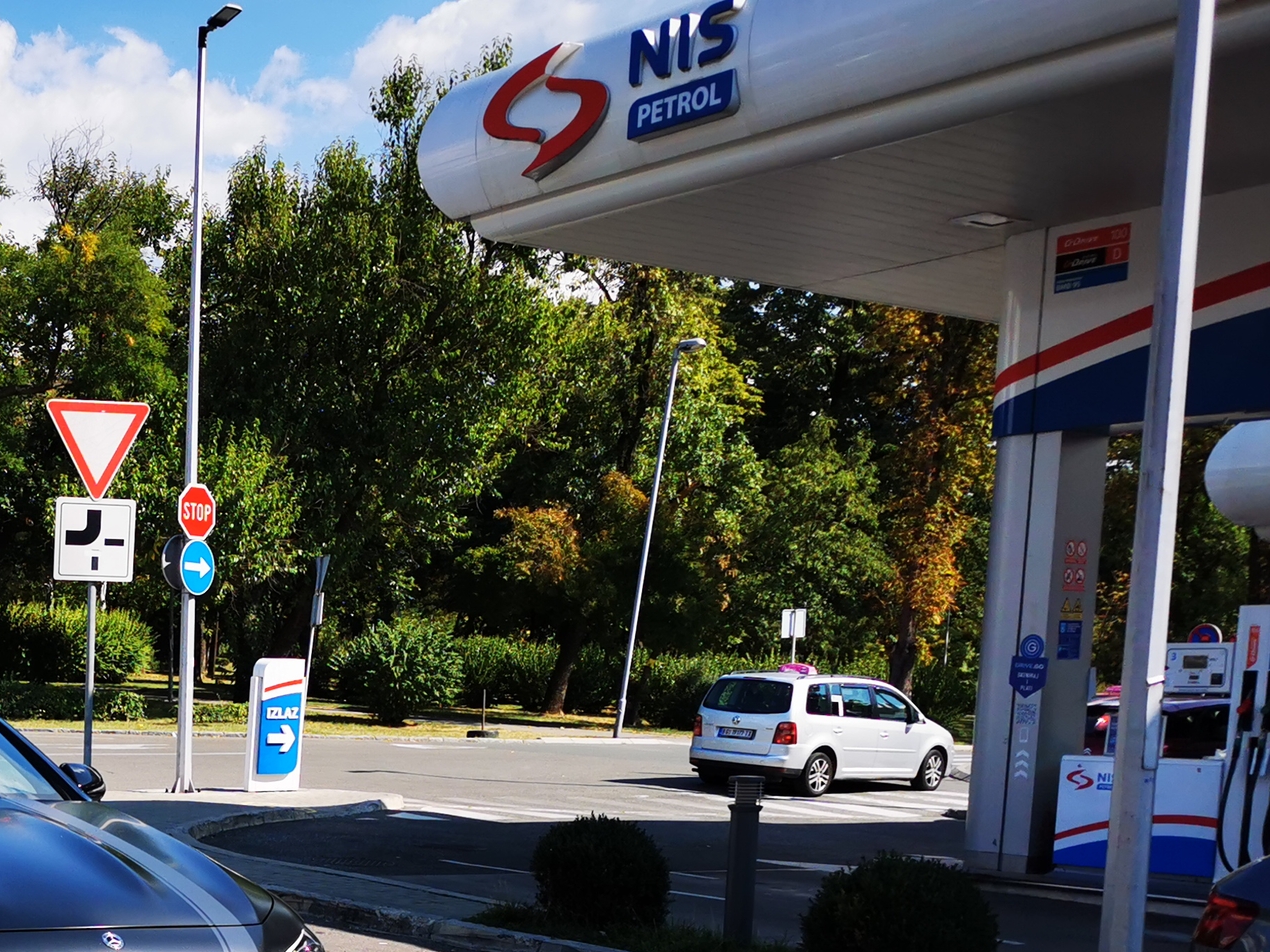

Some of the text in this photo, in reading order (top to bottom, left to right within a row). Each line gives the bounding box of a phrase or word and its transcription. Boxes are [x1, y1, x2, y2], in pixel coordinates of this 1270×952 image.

[629, 0, 740, 87] NIS
[636, 82, 722, 129] PETROL
[1112, 248, 1122, 259] D
[183, 502, 211, 522] STOP
[1027, 642, 1037, 653] G
[266, 706, 300, 720] IZLAZ
